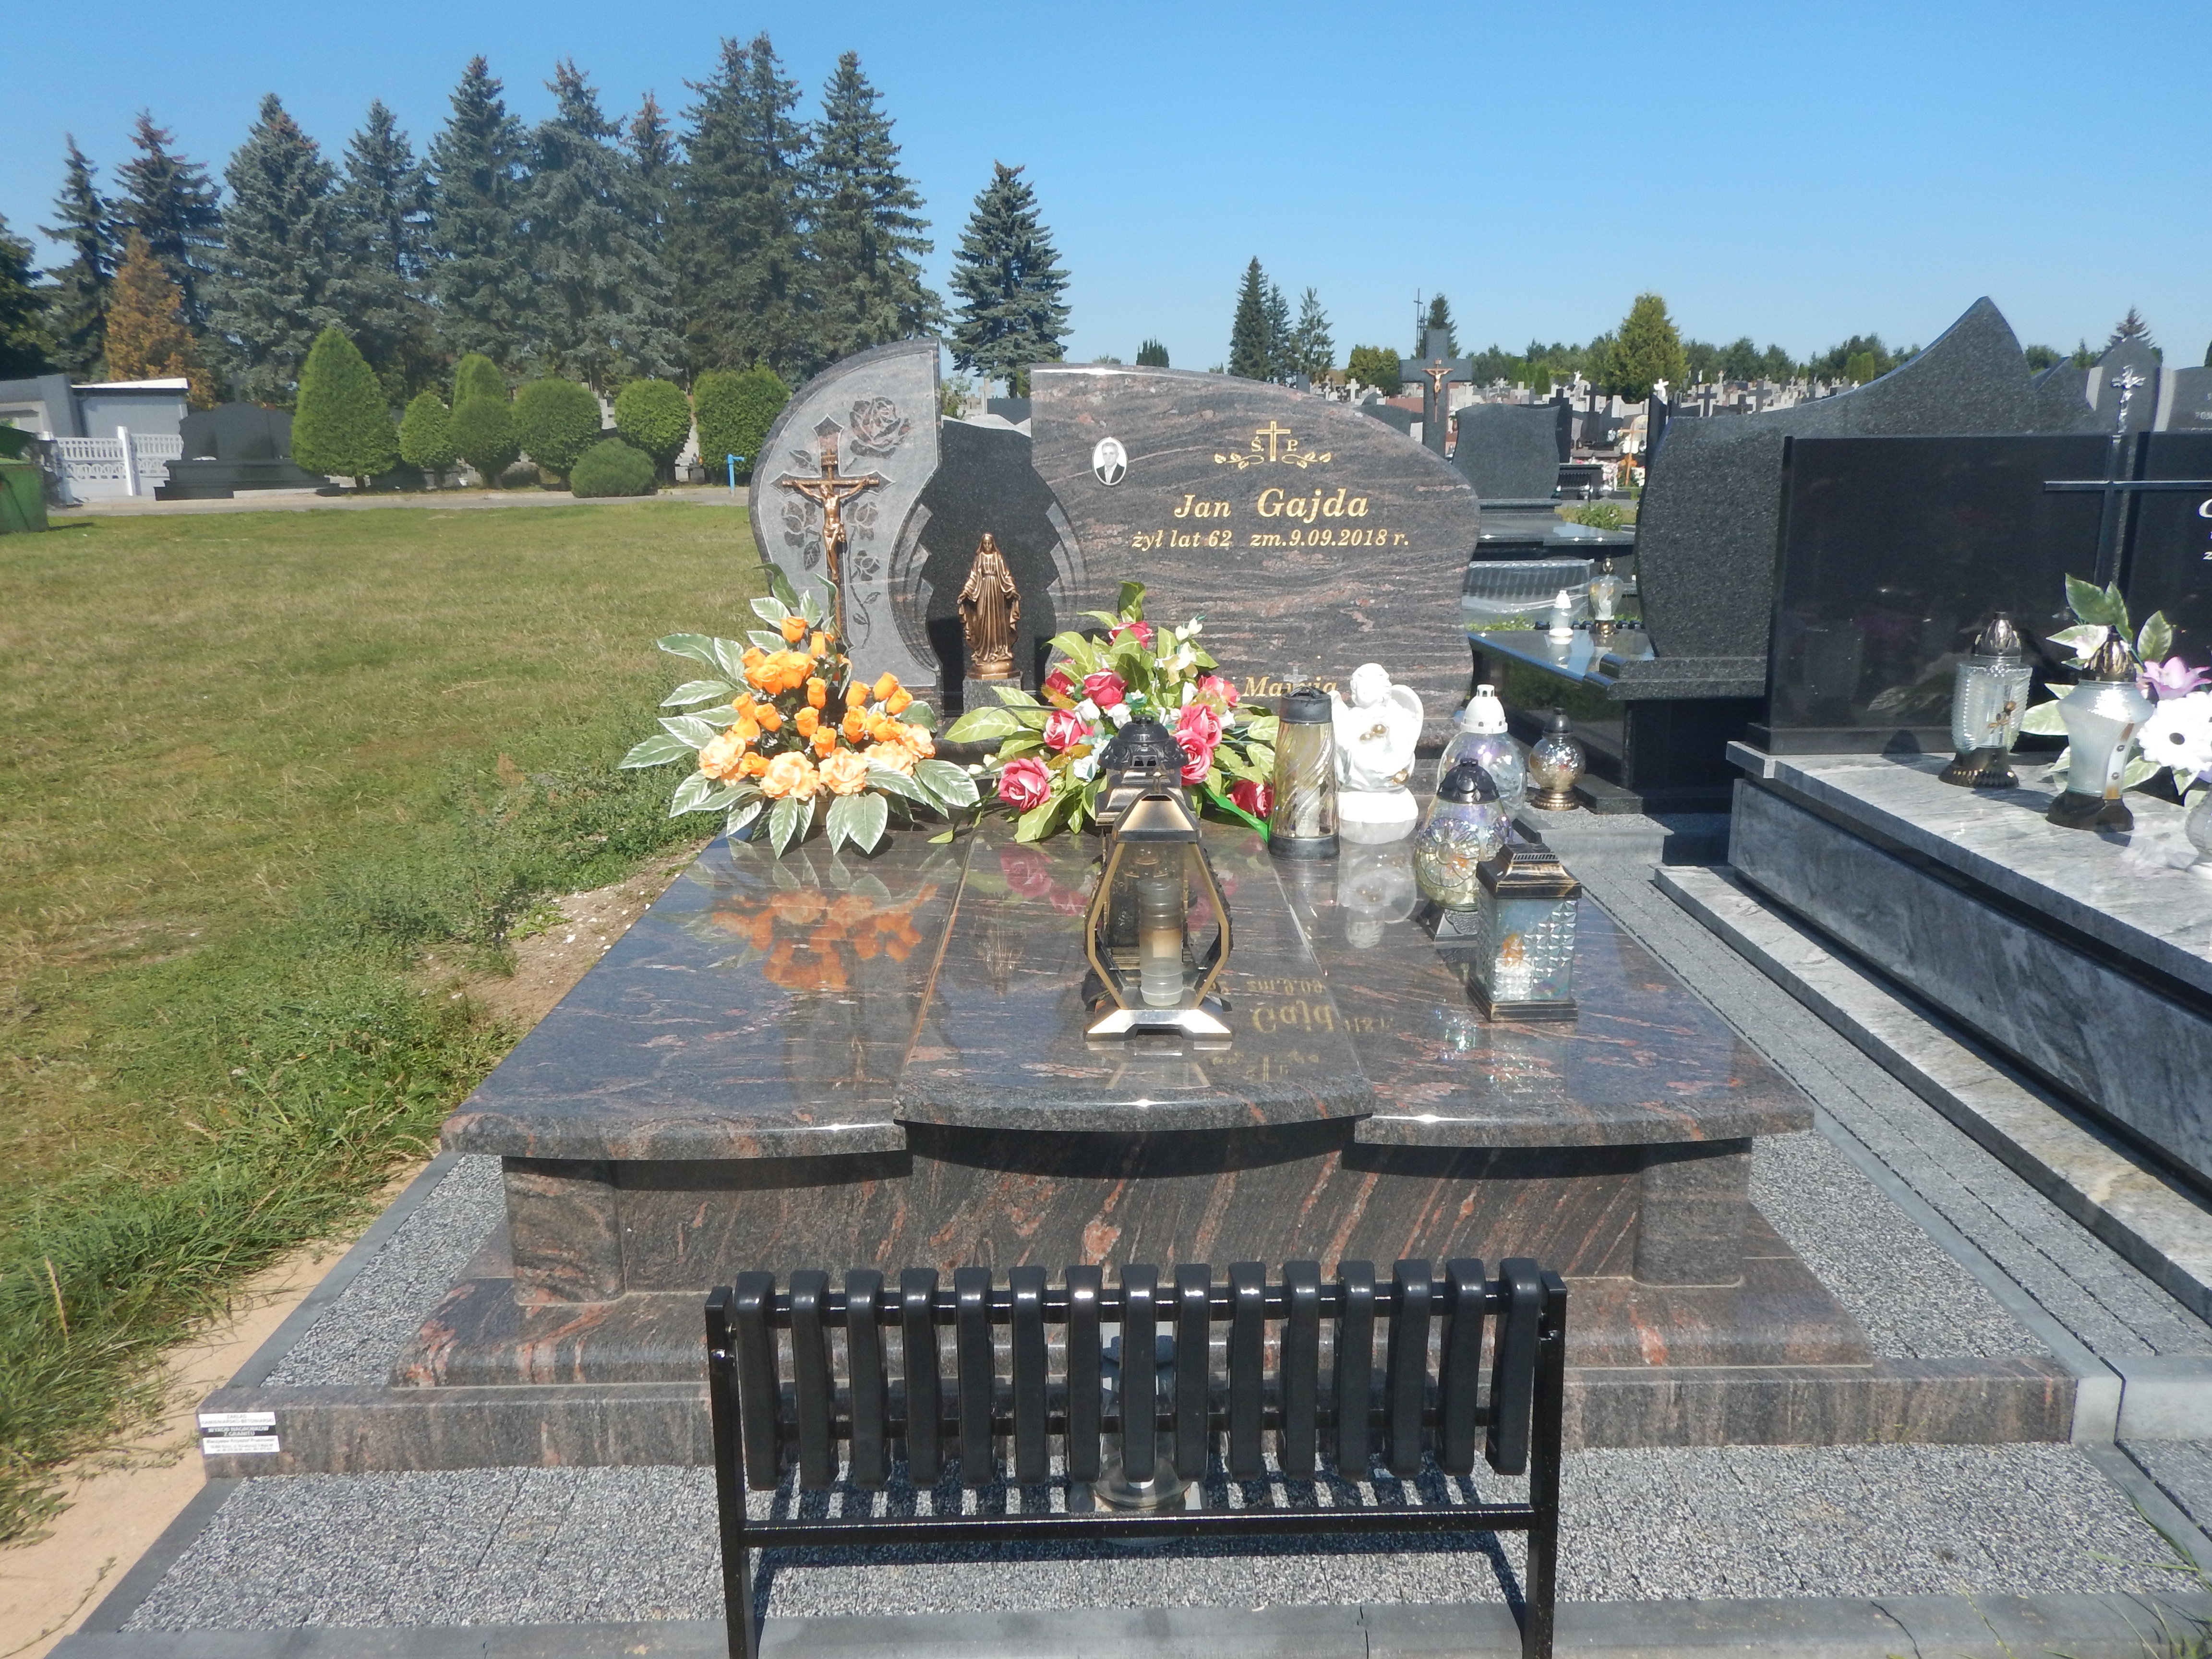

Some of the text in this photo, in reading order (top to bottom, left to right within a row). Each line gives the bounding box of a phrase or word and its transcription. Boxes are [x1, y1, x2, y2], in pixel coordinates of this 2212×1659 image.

[1287, 439, 1298, 451] P.
[1174, 488, 1369, 523] Jan Gajda
[1132, 529, 1164, 552] żył
[1170, 529, 1201, 547] lat
[1208, 530, 1232, 547] 62
[1394, 533, 1409, 546] r.
